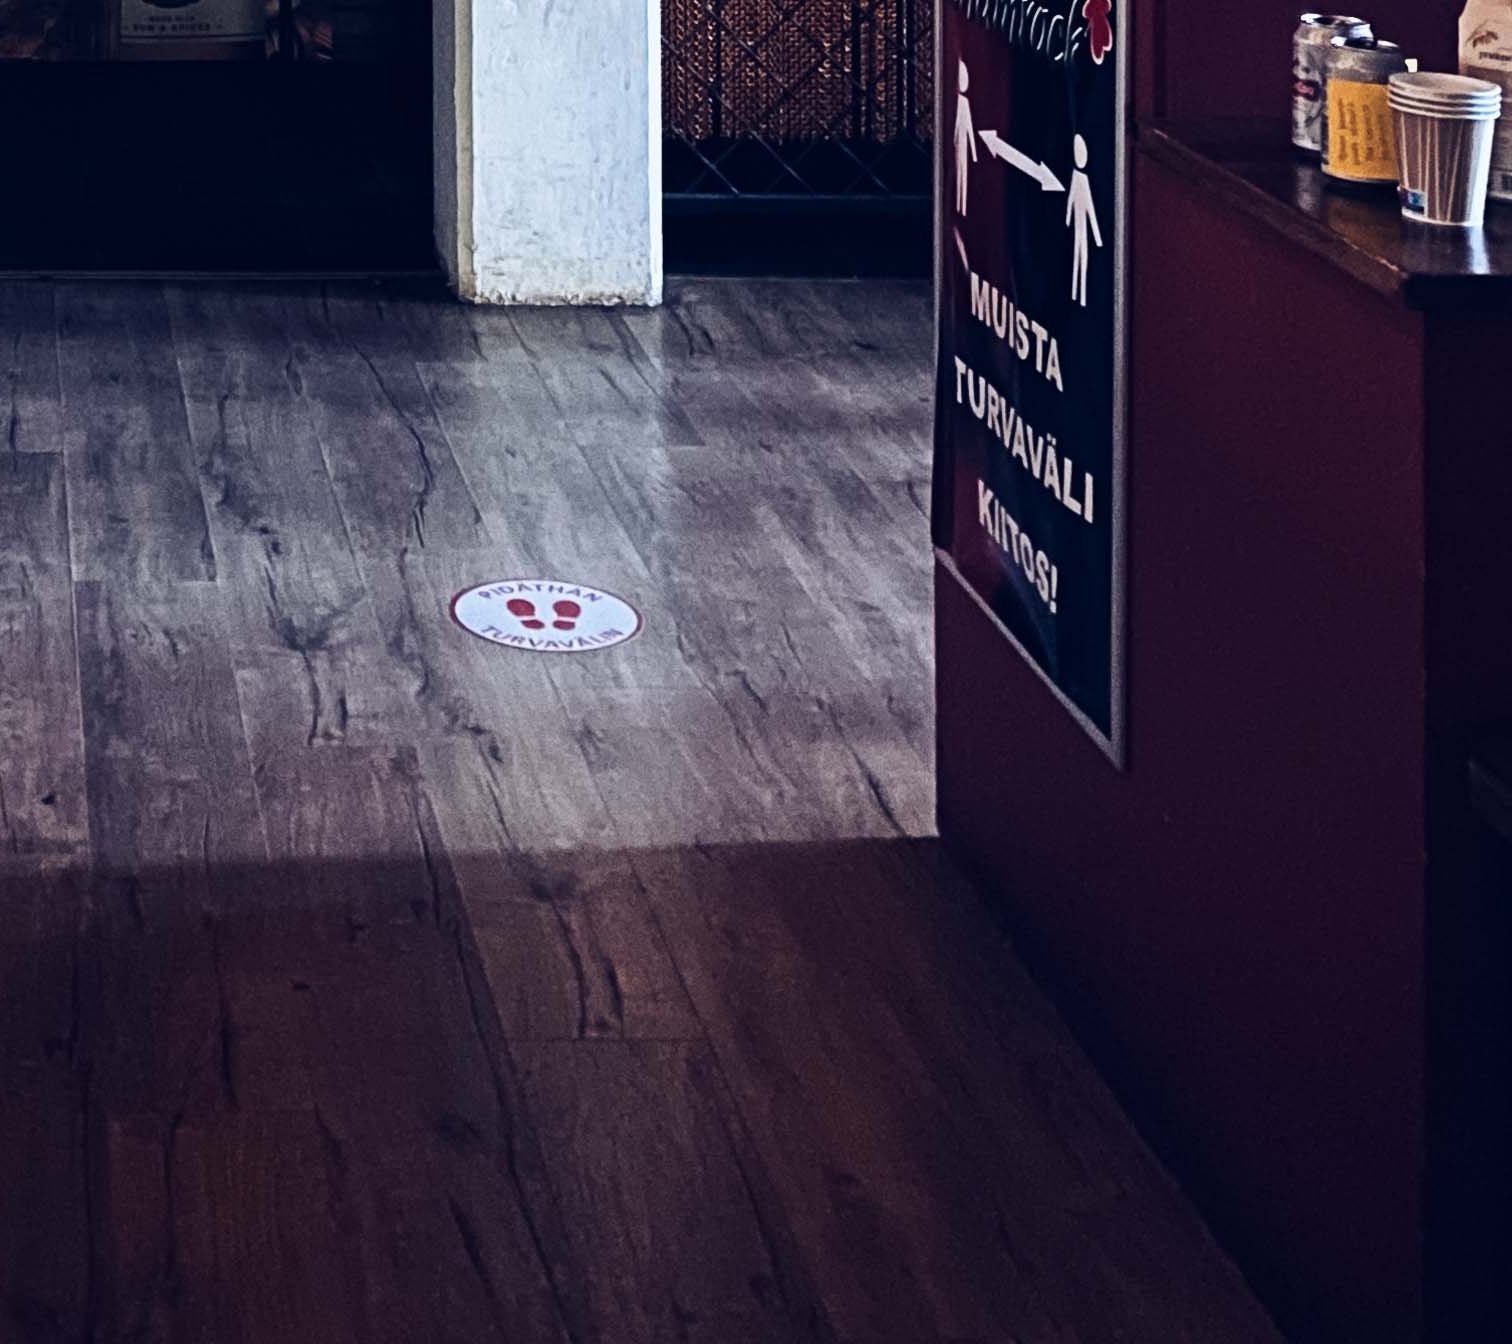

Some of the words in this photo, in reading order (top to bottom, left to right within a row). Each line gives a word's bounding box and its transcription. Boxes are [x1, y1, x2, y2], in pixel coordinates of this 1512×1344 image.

[969, 271, 1065, 393] MUISTA
[954, 355, 1095, 525] TURVAVÄLI
[977, 478, 1059, 615] KIITOS!
